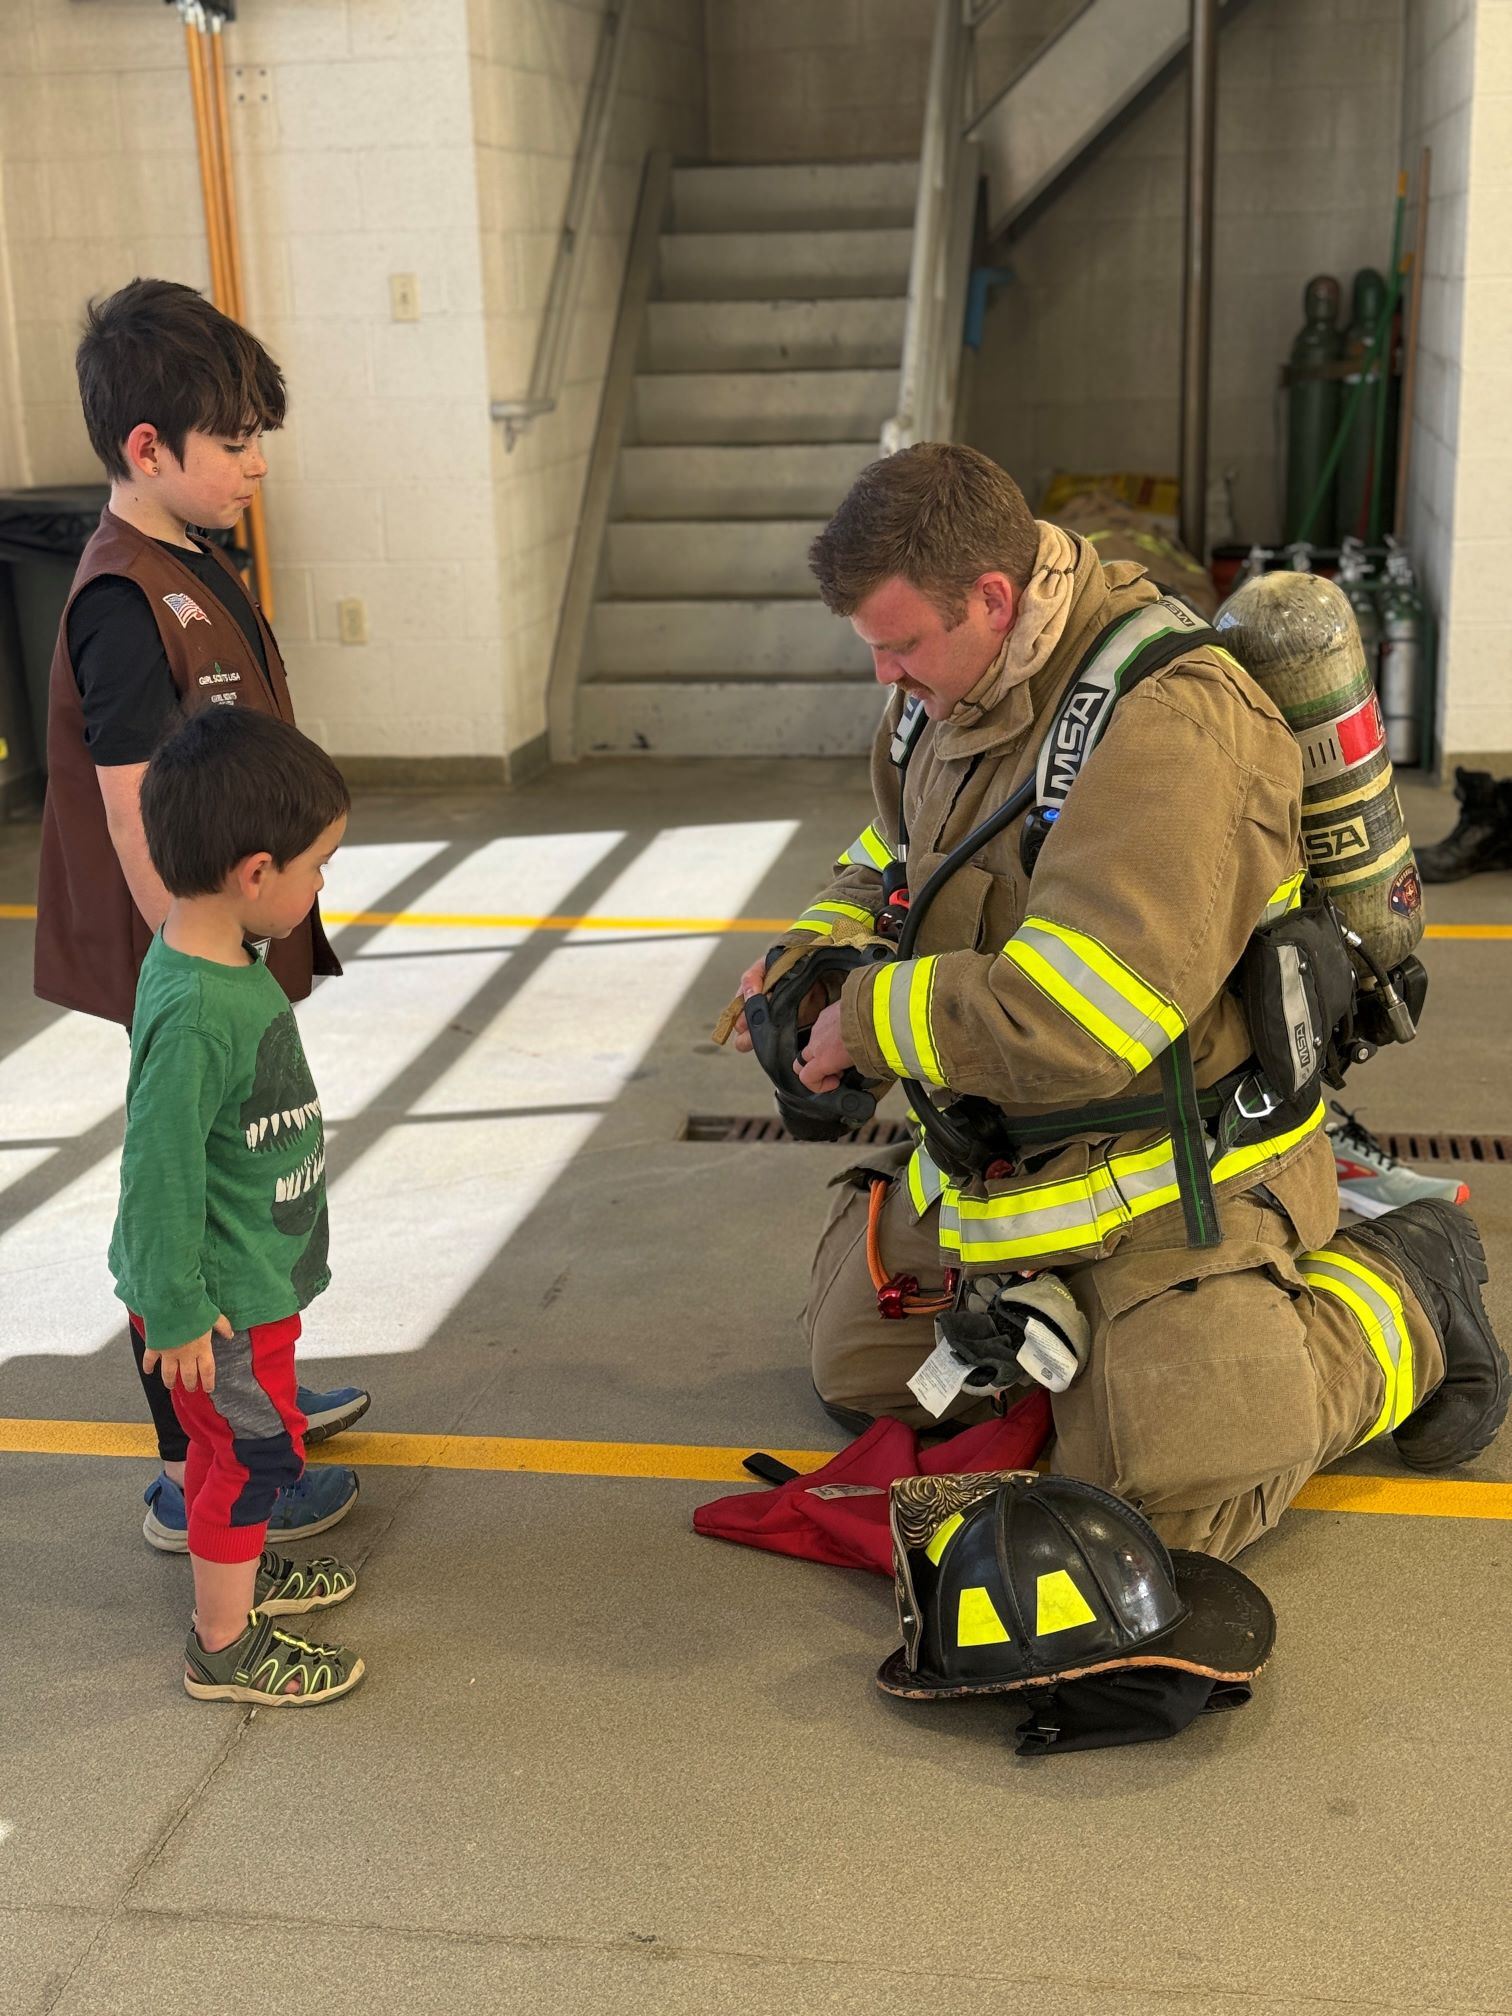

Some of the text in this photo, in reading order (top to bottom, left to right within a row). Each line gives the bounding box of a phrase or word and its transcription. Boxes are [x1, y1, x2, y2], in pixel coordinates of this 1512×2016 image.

[1158, 600, 1194, 626] MSA
[228, 672, 241, 681] USA
[1050, 692, 1104, 792] MSA
[1305, 824, 1366, 861] SA
[1296, 1023, 1310, 1065] MSA
